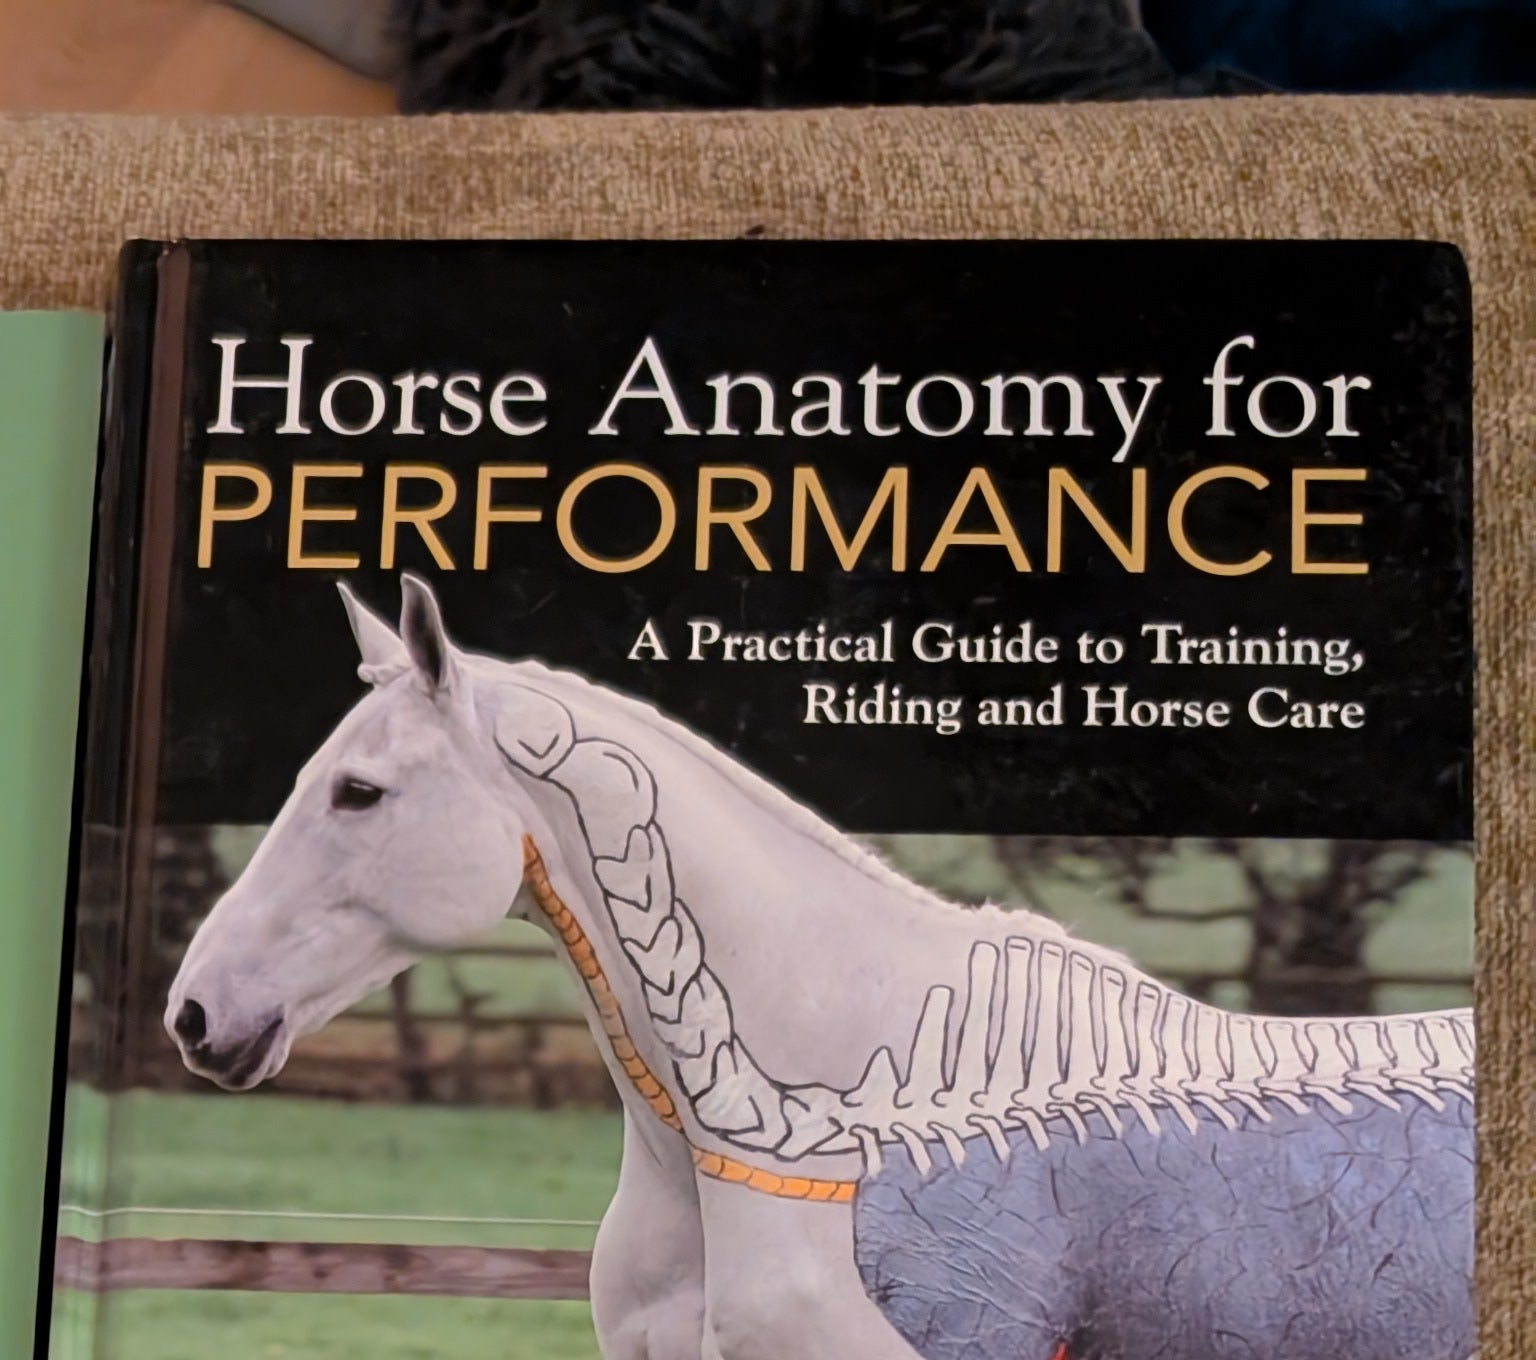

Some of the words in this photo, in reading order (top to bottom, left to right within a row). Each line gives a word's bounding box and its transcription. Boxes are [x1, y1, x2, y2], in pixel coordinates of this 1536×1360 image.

[206, 336, 549, 440] Horse
[588, 335, 1164, 464] Anatomy
[1203, 335, 1372, 440] for
[196, 462, 1370, 576] PERFORMANCE
[626, 620, 668, 663] A
[685, 621, 895, 665] Practical
[910, 622, 1061, 667] Guide
[1076, 631, 1126, 668] to
[1139, 624, 1365, 677] Training,
[801, 682, 965, 737] Riding
[977, 683, 1065, 729] and
[1080, 684, 1232, 730] Horse
[1246, 687, 1367, 731] Care
